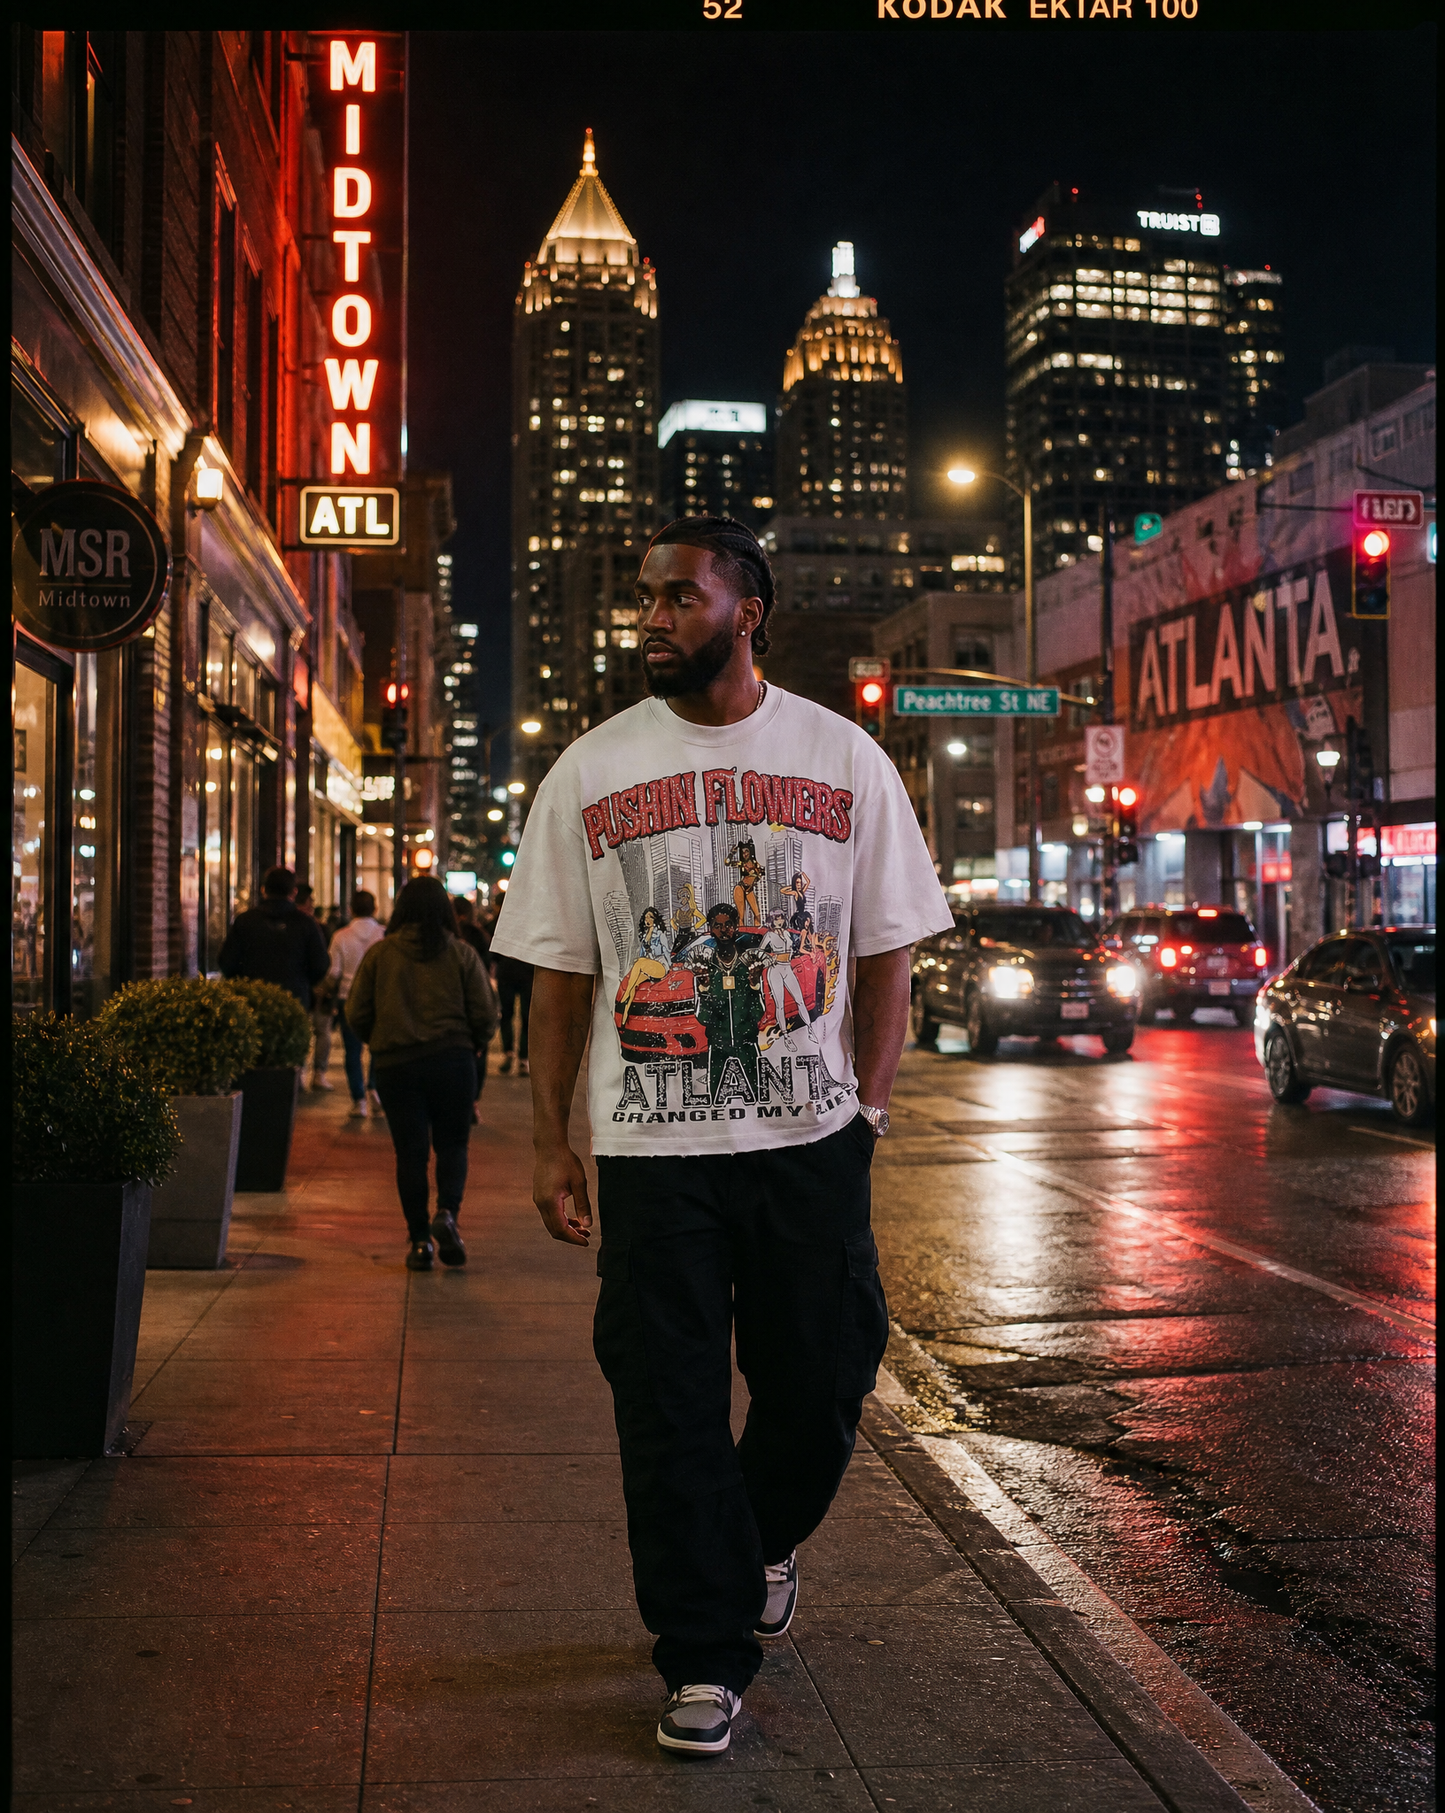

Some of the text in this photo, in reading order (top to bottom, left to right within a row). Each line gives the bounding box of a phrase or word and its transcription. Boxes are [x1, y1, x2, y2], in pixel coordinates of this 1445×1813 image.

[1137, 210, 1200, 232] TRUIST
[323, 39, 379, 476] MIDTOWN
[310, 496, 390, 536] ATL
[39, 528, 131, 578] MSR
[38, 589, 131, 608] Midtown
[1136, 569, 1345, 723] ATLANTA
[904, 691, 1051, 712] Peachtree St NE
[582, 767, 854, 860] PUSHIN FLOWERS
[757, 1104, 804, 1119] MY
